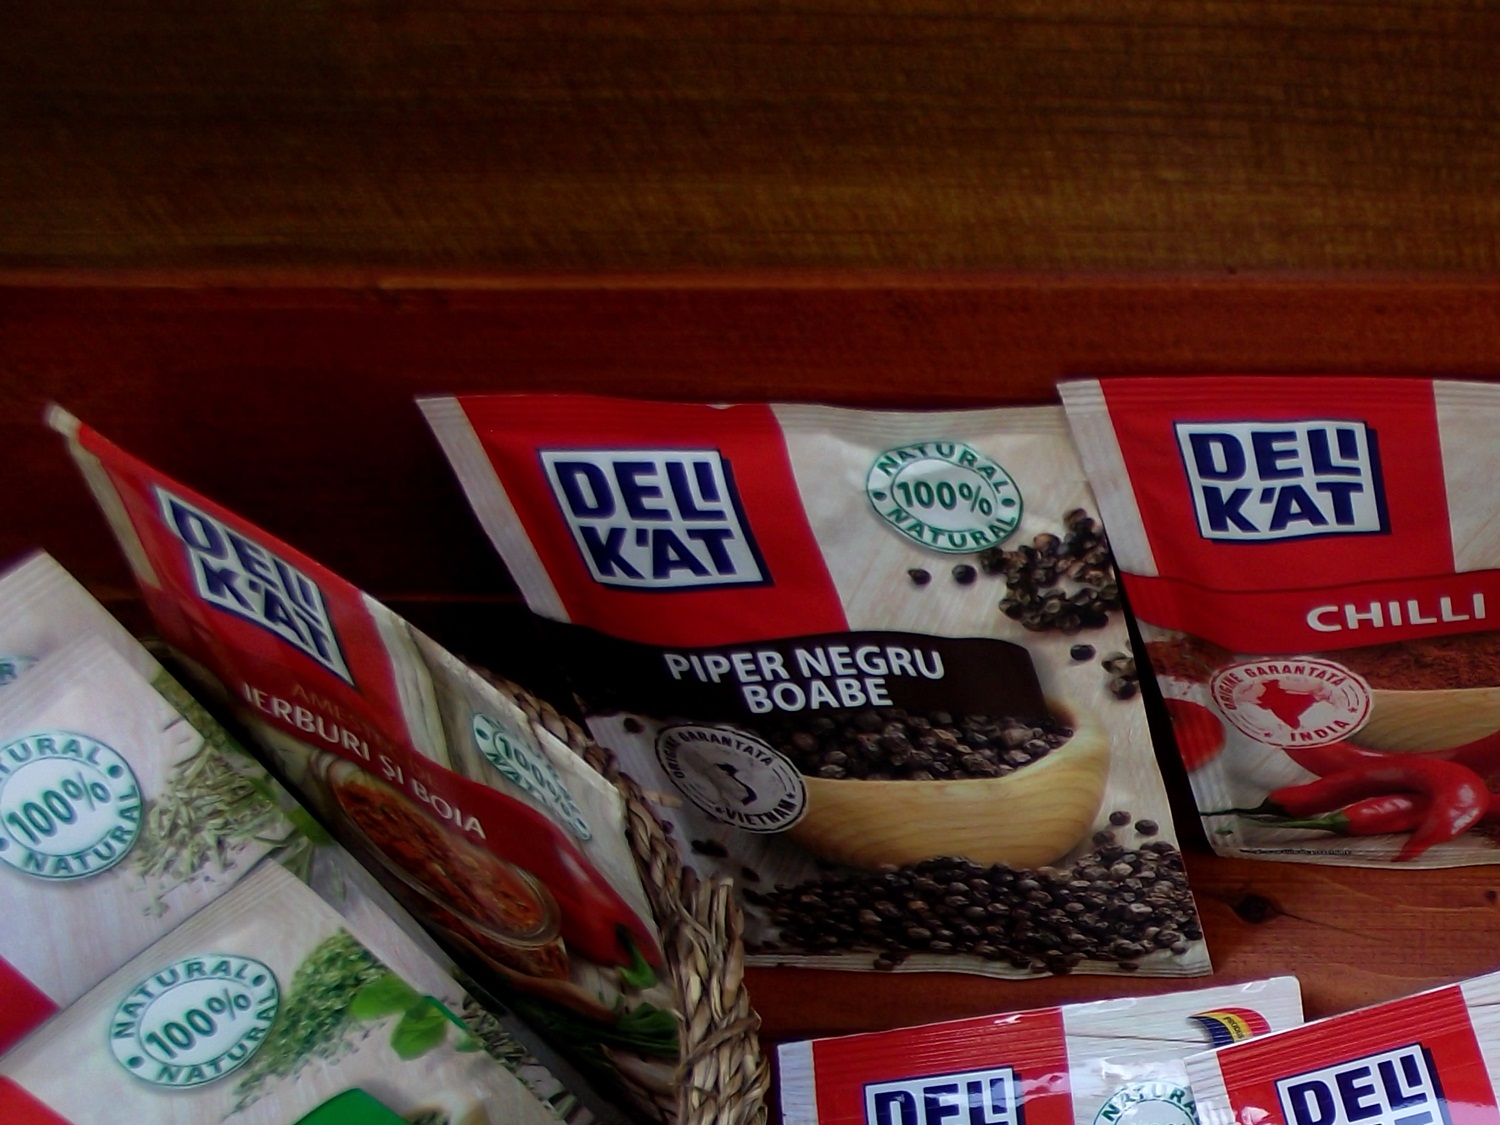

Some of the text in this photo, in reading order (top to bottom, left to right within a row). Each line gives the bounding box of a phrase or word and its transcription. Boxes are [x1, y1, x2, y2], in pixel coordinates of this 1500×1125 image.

[877, 444, 1009, 494] NATURAL
[1189, 428, 1361, 481] DELI
[554, 461, 728, 521] DELI
[897, 481, 992, 516] 100%
[887, 509, 1016, 548] NATURAL
[1306, 593, 1485, 632] CHILLI
[664, 646, 945, 683] PIPER NEGRU
[742, 678, 893, 714] BOABE
[1290, 719, 1349, 742] INDIA
[242, 682, 370, 761] IERBURI
[411, 778, 486, 839] BOIA
[7, 771, 112, 845] 100%
[24, 785, 141, 874] NATURAL
[725, 799, 798, 827] VIETNAM
[113, 961, 250, 1039] NATURAL
[146, 987, 251, 1059] 100%
[156, 988, 278, 1082] NATURAL
